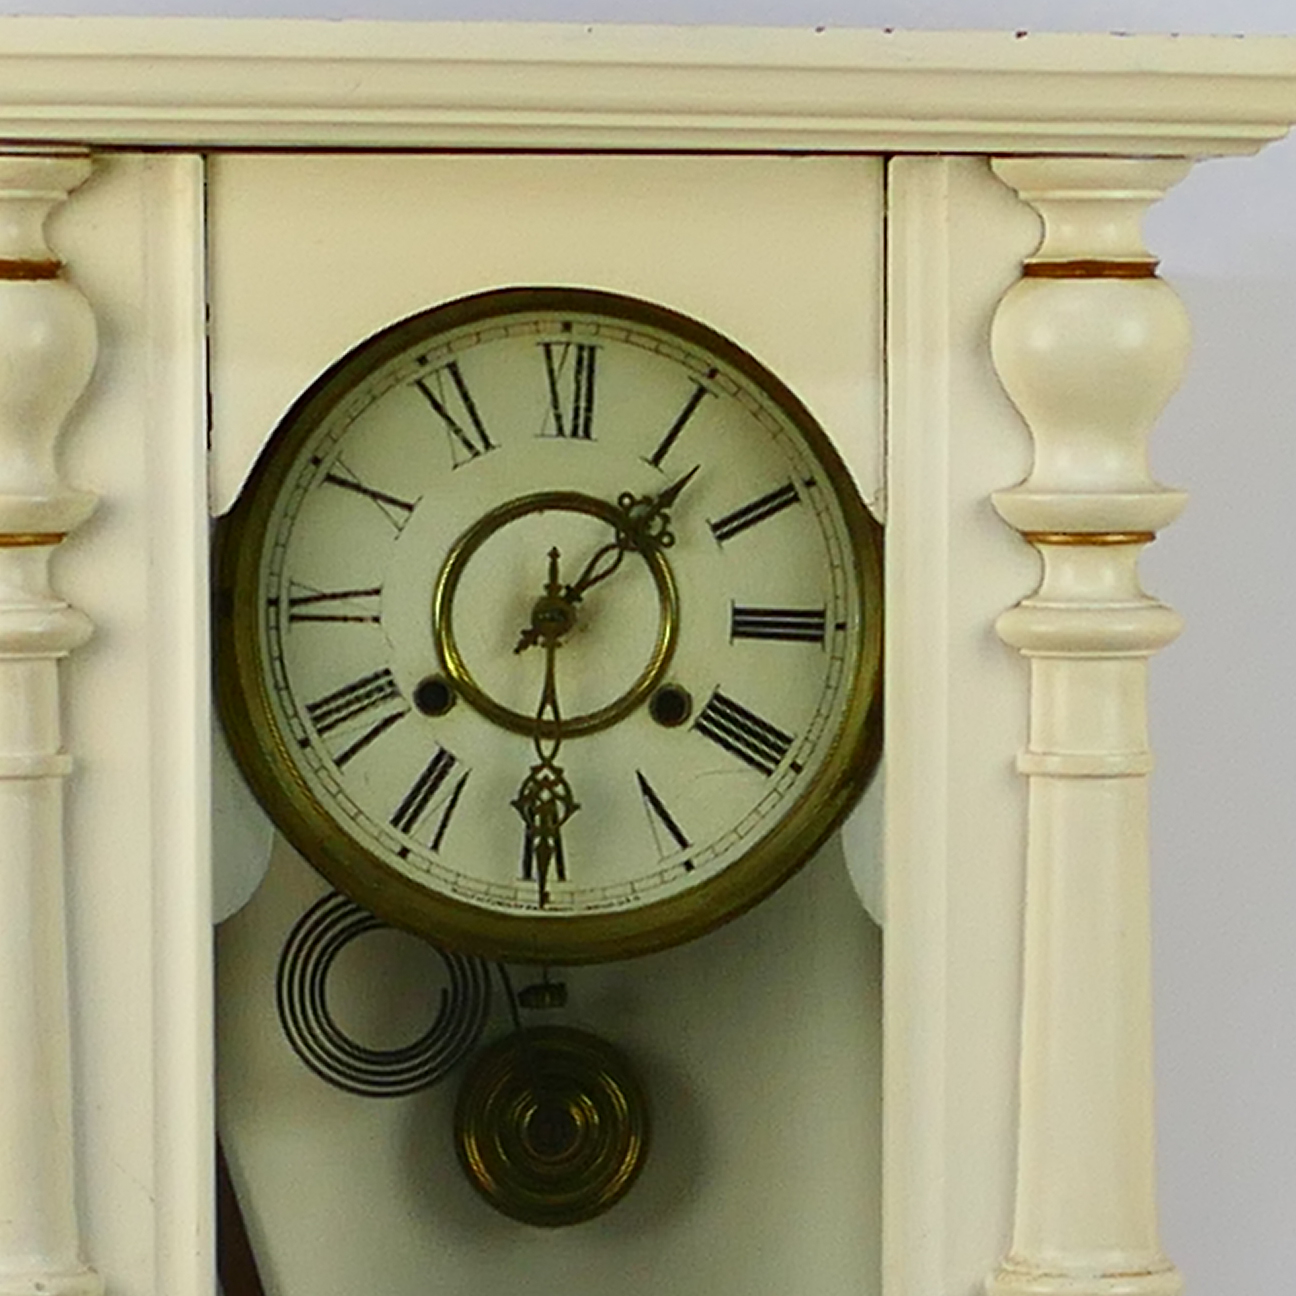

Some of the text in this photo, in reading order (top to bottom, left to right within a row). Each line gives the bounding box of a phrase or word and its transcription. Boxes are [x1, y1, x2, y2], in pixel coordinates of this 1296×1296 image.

[409, 361, 500, 469] XI
[533, 342, 604, 440] XII
[641, 376, 719, 469] I
[319, 453, 424, 540] X
[707, 476, 808, 545] II
[288, 581, 382, 624] IX
[729, 600, 828, 645] III
[304, 667, 412, 767] VIII
[694, 688, 798, 777] IIII
[389, 743, 473, 852] VII
[636, 768, 699, 862] V
